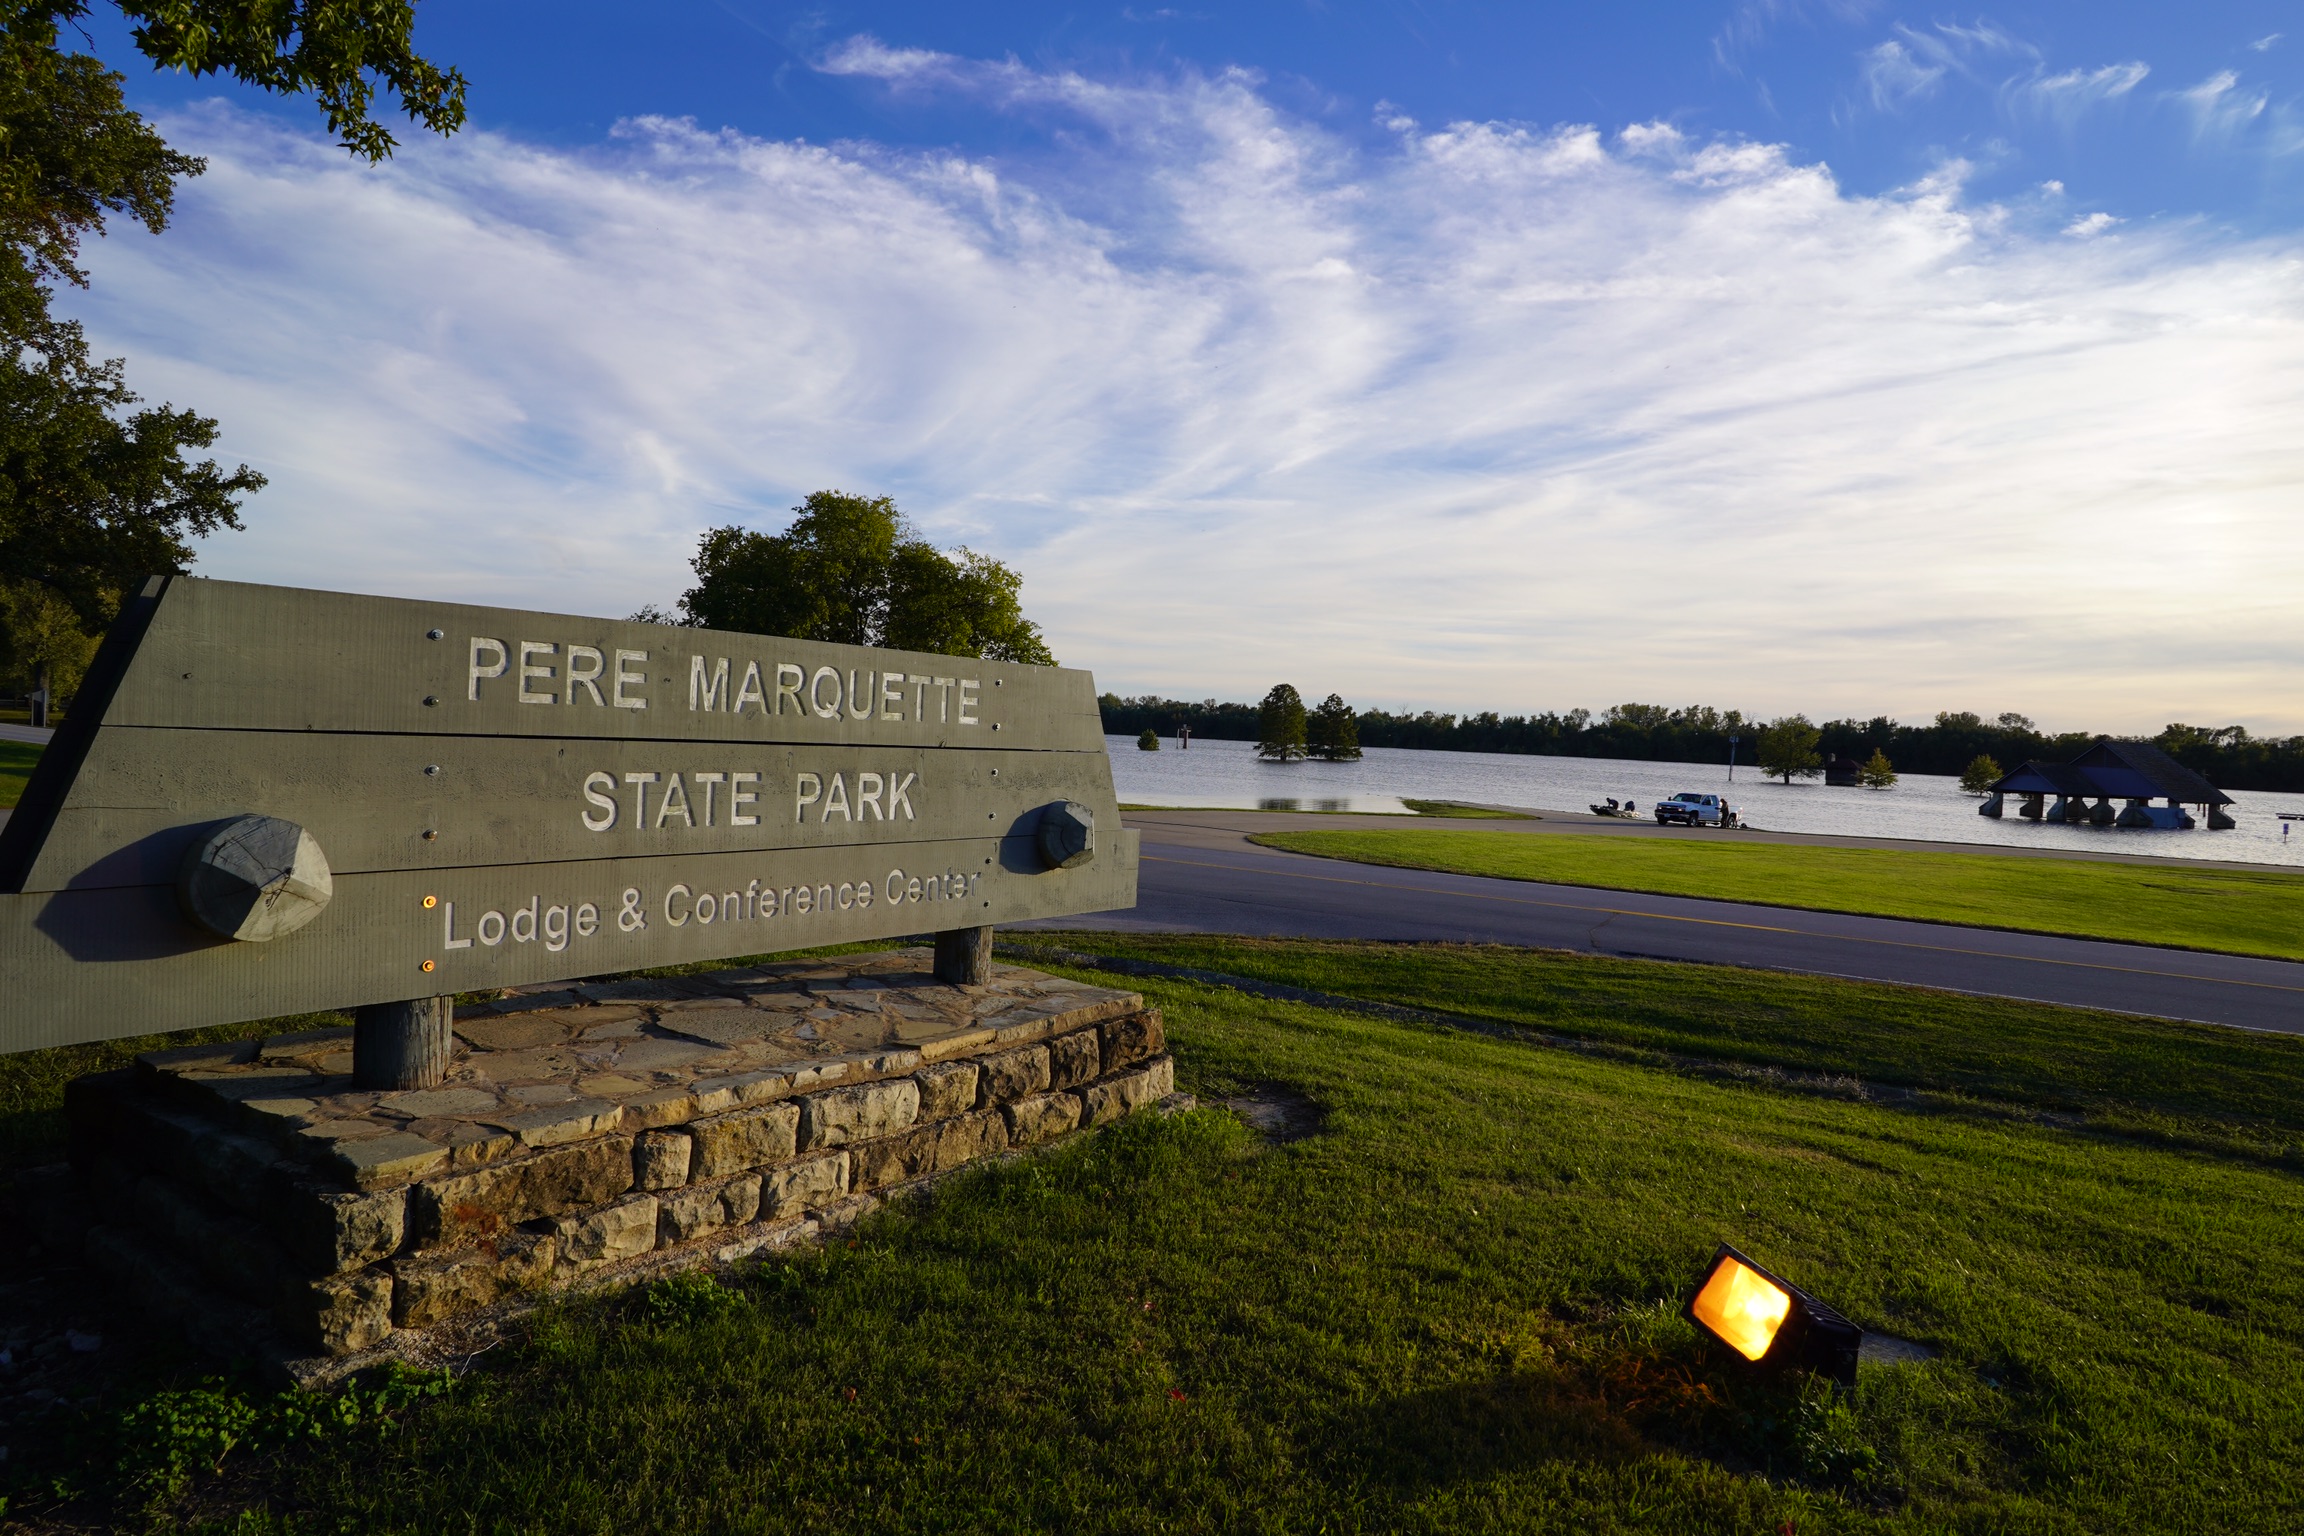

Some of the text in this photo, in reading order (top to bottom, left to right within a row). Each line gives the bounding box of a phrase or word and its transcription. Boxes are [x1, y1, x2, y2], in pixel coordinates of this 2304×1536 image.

[468, 636, 980, 726] PERE MARQUETTE
[581, 772, 917, 832] STATE PARK
[444, 868, 982, 952] Lodge & Conference Center
